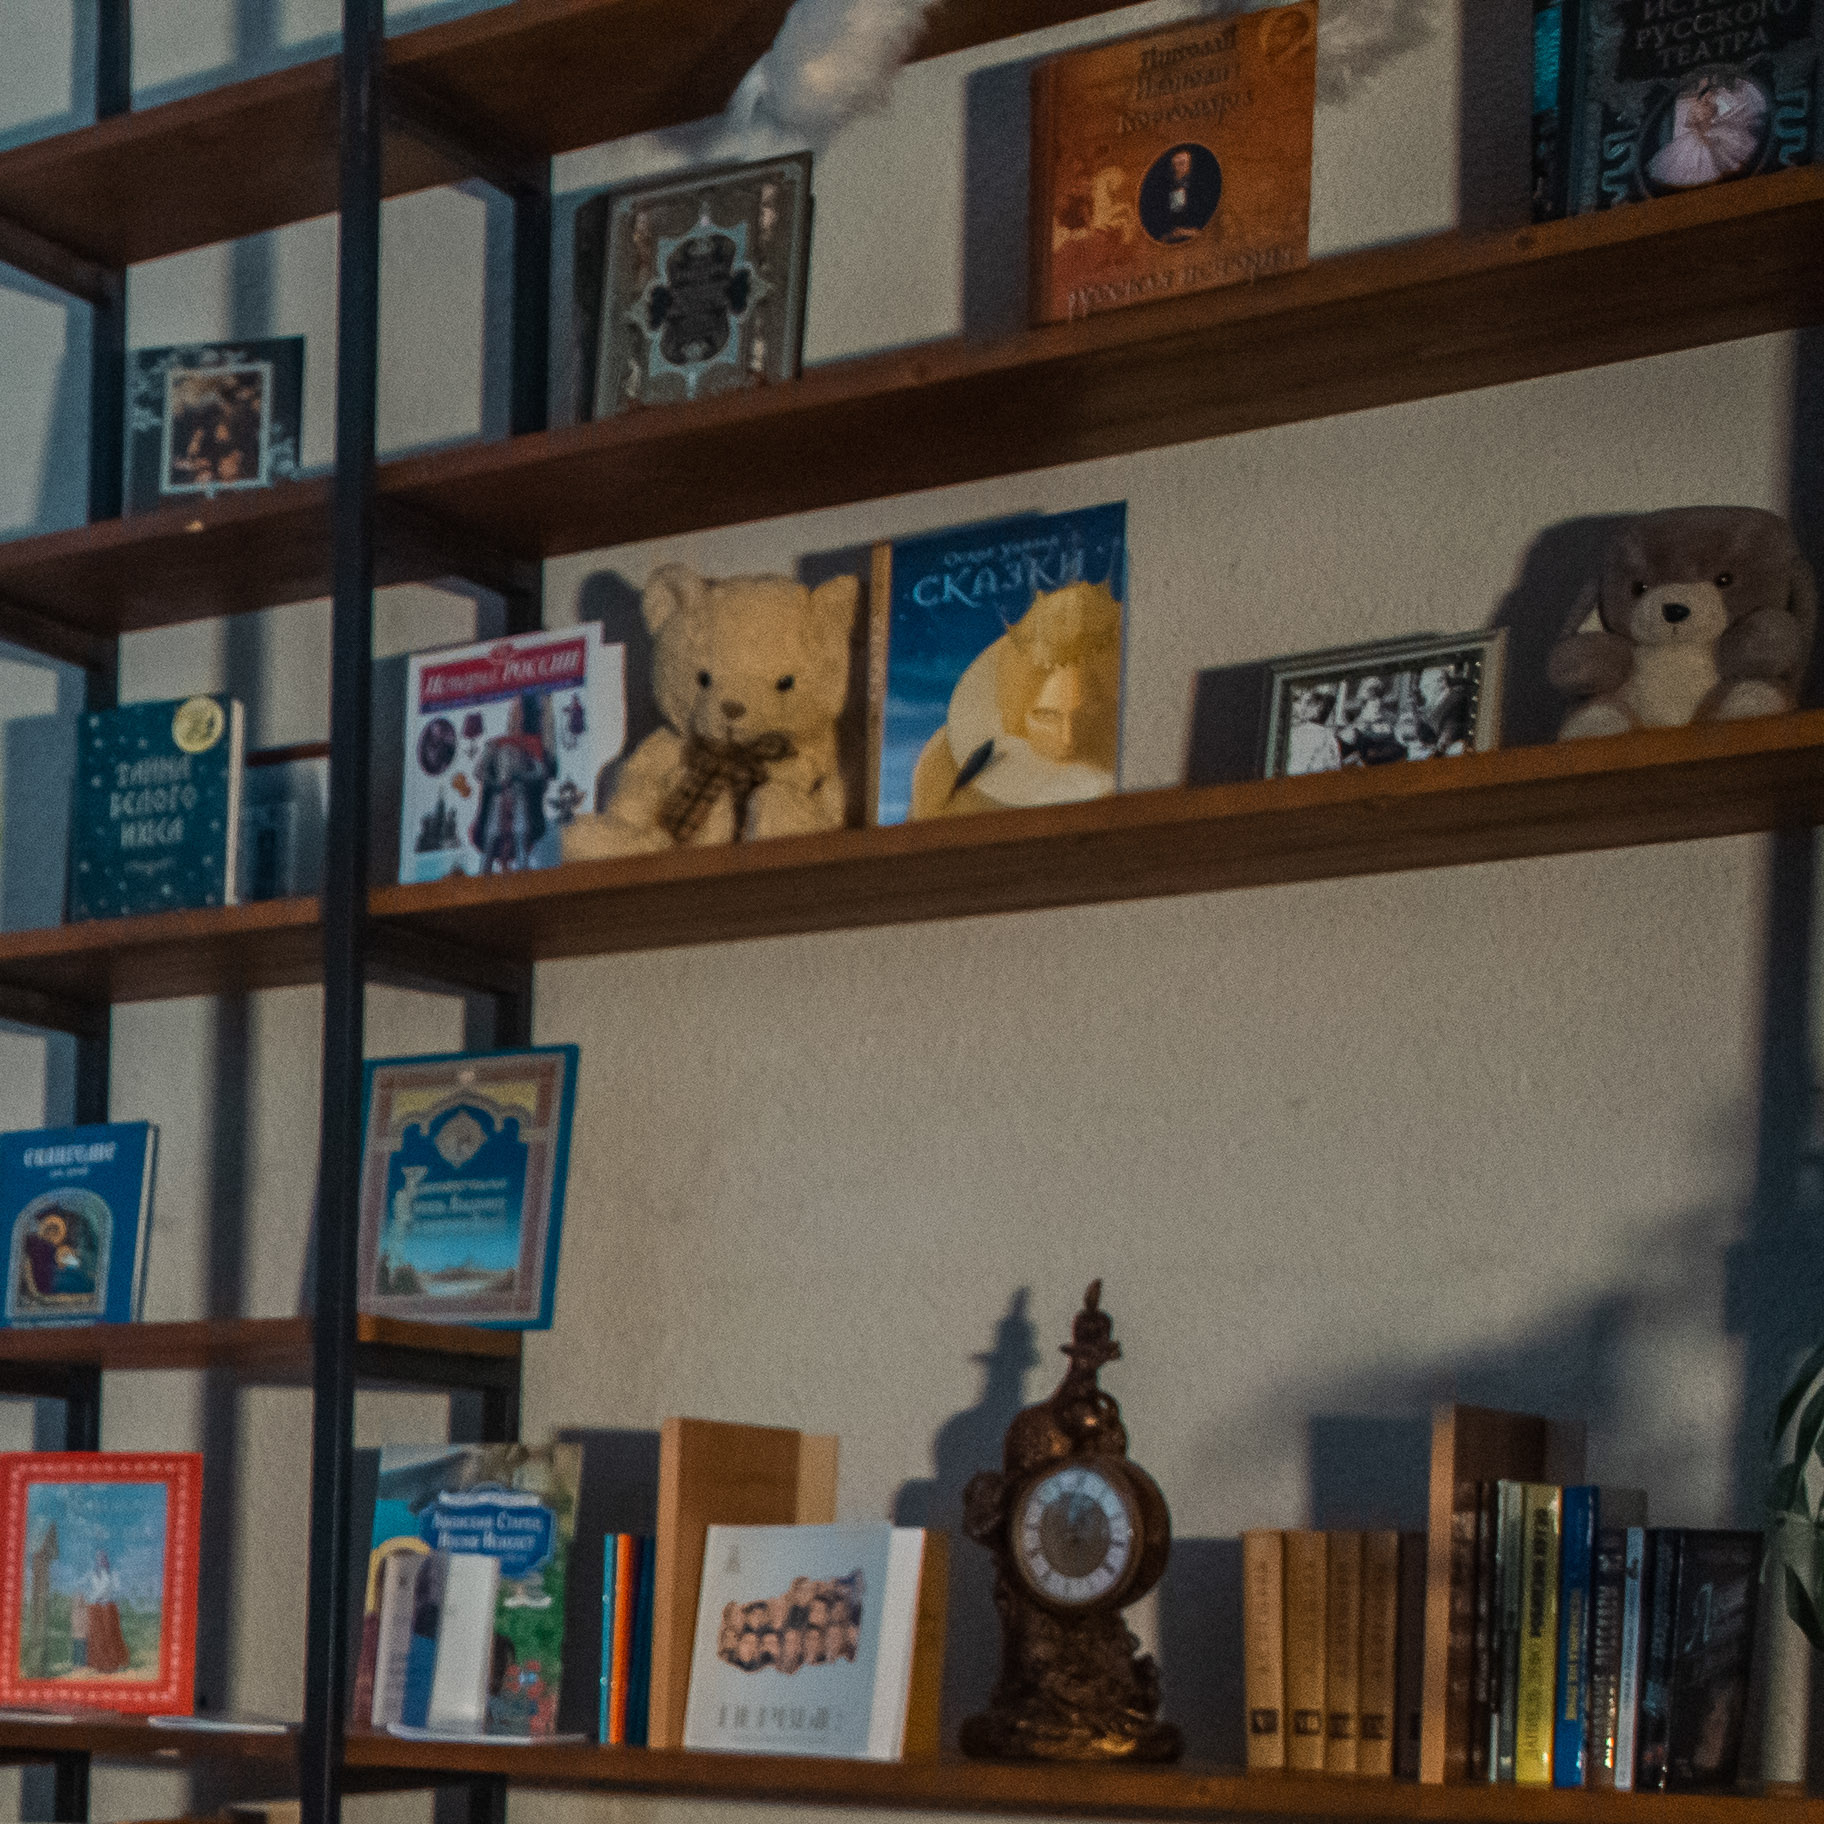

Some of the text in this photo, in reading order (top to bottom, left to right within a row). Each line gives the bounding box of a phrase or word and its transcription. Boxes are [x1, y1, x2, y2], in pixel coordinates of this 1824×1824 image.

[1635, 0, 1798, 49] РУССКОГО
[1655, 25, 1770, 70] ТЕАТРА
[913, 550, 1085, 609] СКАЗКИ
